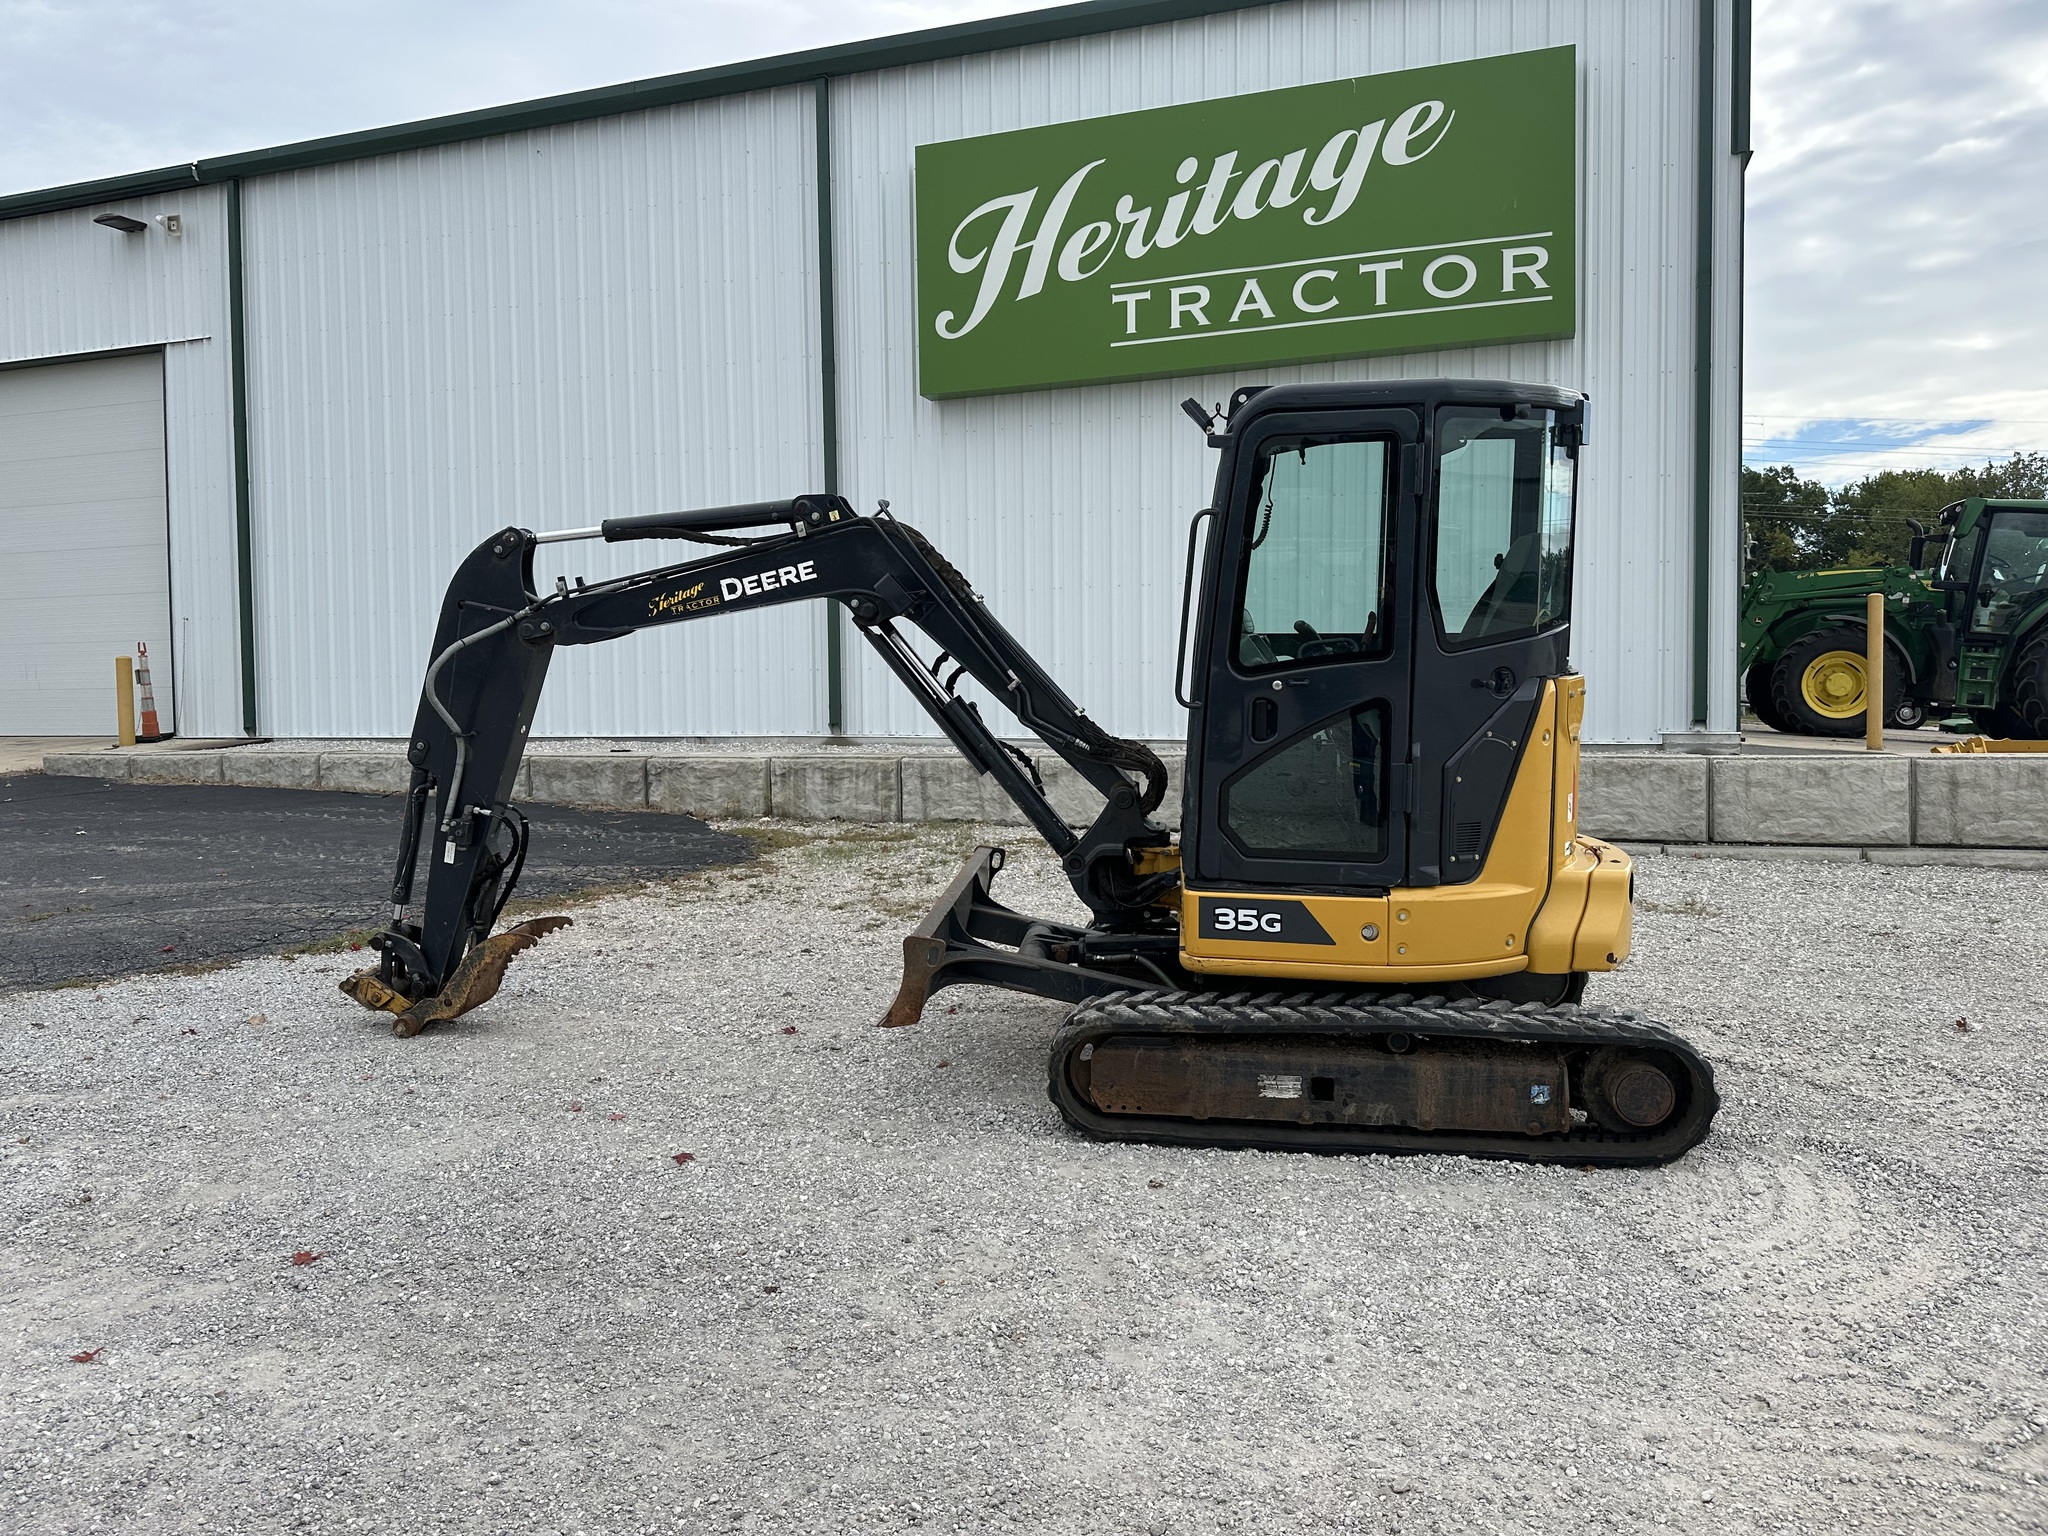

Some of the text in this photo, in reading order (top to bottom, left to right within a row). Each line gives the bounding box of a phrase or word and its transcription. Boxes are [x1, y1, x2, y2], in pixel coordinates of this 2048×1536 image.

[935, 101, 1455, 339] Heritage
[1111, 245, 1551, 334] TRACTOR
[648, 582, 704, 617] Heritage
[719, 560, 818, 602] DEERE
[671, 597, 720, 615] TRACTOR
[1214, 907, 1282, 933] 35G
